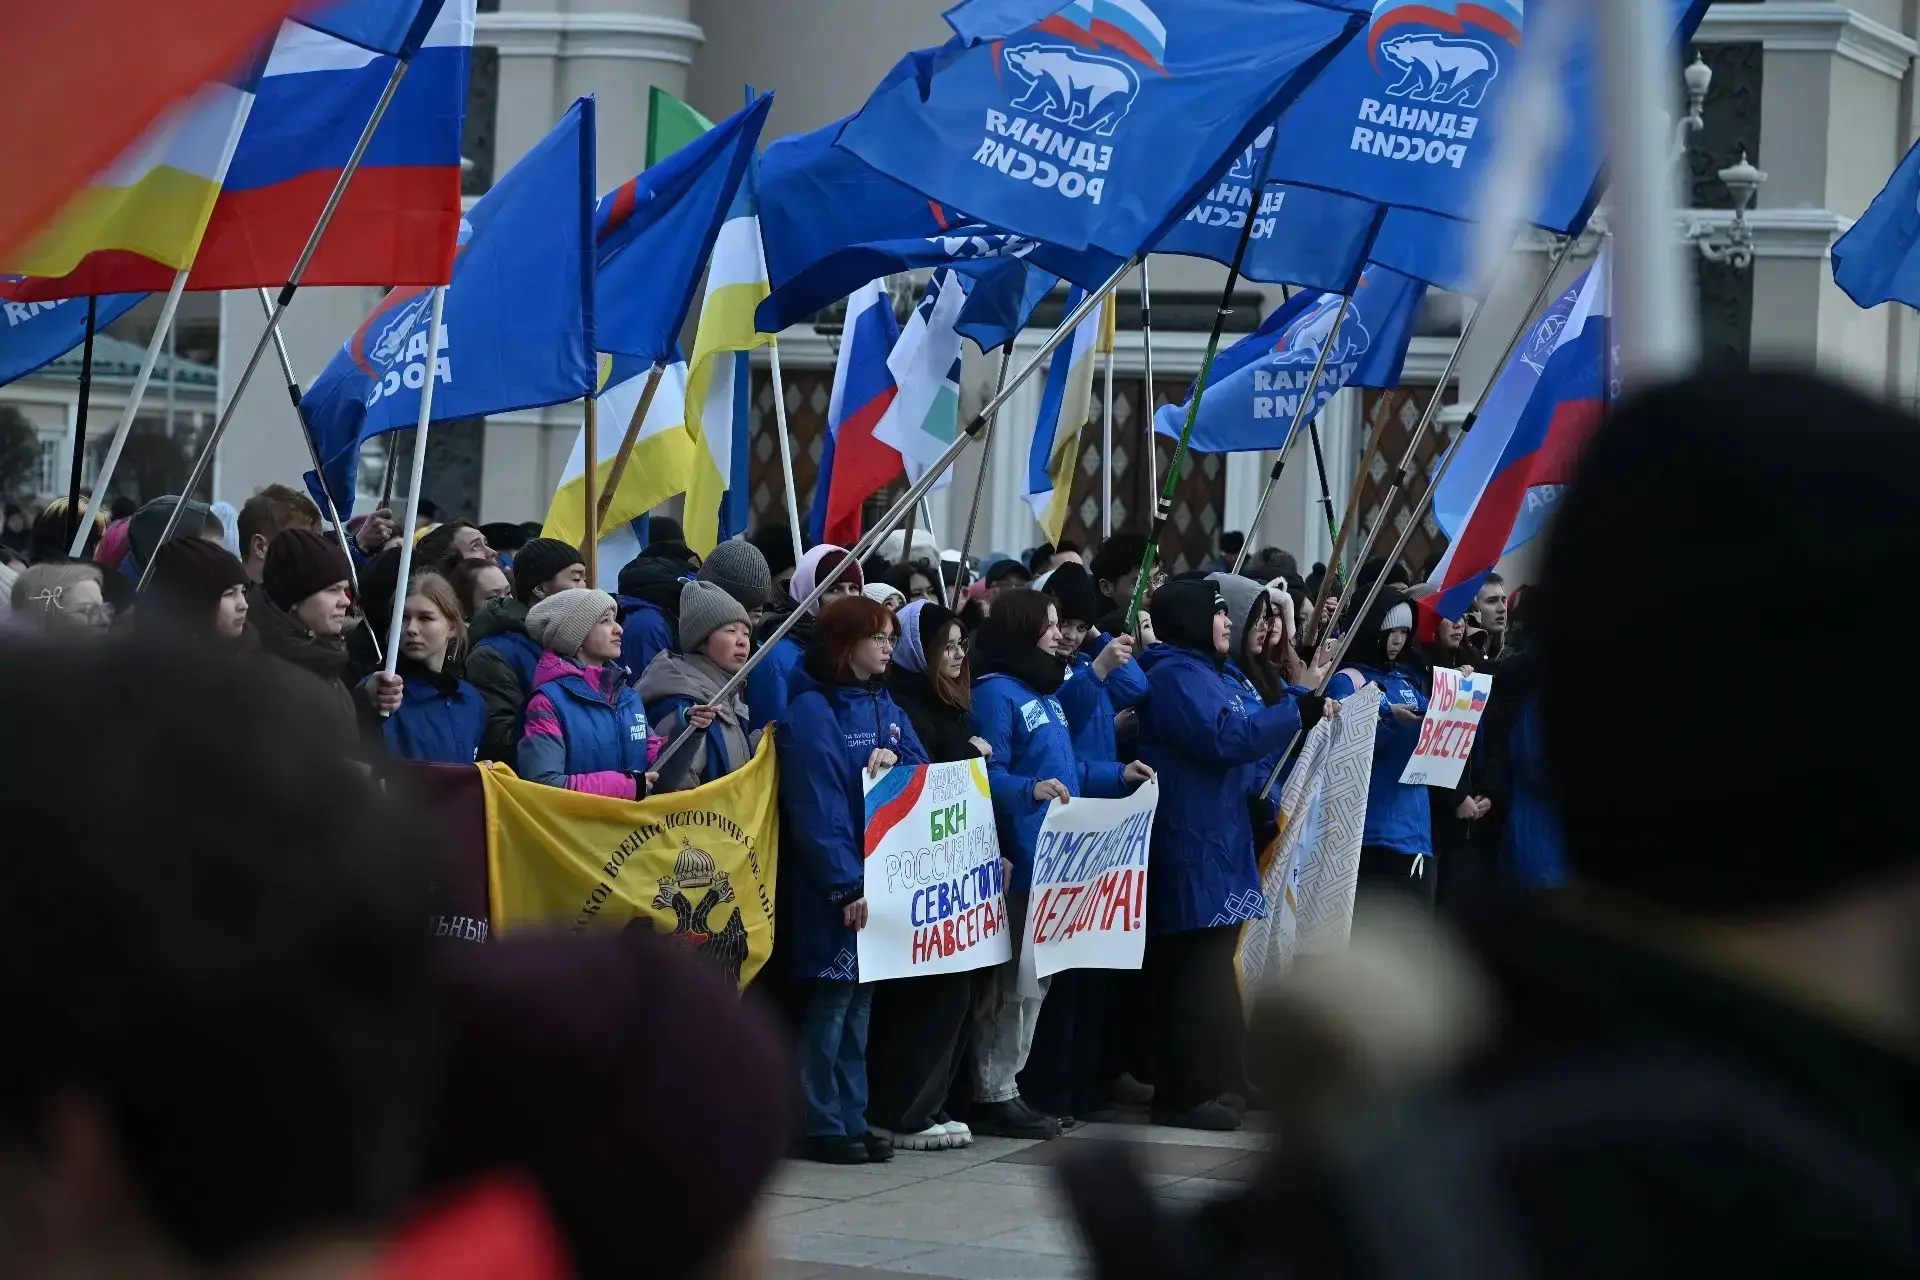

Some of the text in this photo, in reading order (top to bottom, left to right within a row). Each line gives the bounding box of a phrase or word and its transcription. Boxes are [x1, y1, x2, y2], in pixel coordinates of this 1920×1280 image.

[1429, 670, 1457, 712] МЫ
[1414, 717, 1478, 760] ВМЕСТЕ
[930, 799, 967, 842] БКН
